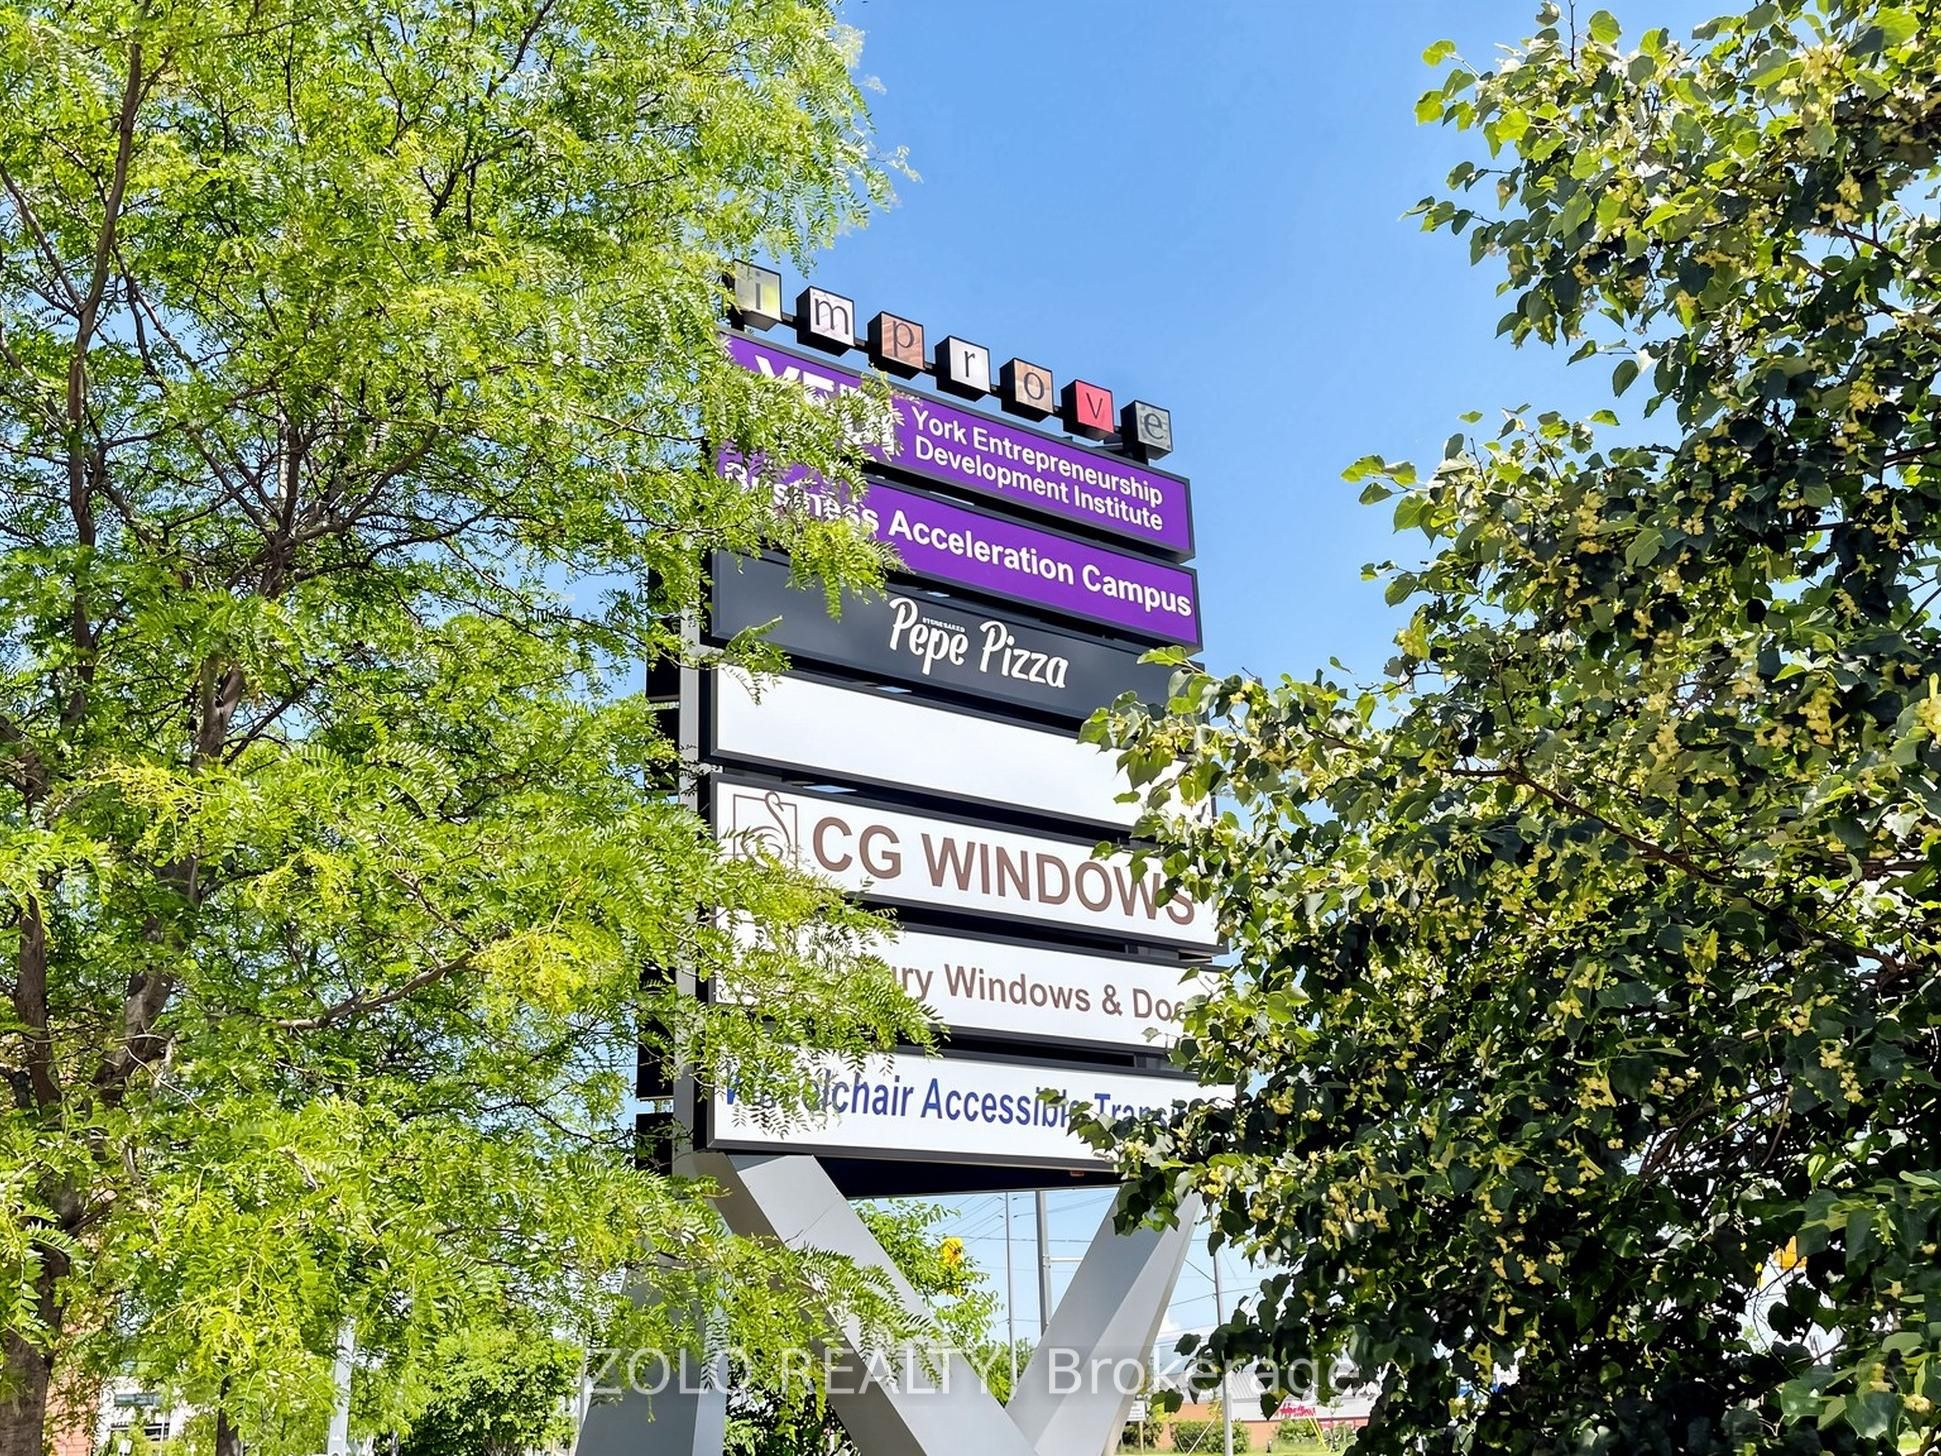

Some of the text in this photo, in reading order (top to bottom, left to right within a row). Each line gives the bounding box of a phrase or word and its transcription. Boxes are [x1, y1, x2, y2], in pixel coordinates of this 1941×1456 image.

[911, 407, 1163, 507] York Entrepreneurship
[915, 434, 1163, 533] Development Institute
[888, 509, 1075, 585] Acceleration
[1081, 564, 1192, 617] Campus
[889, 597, 1069, 689] Pepe Pizza
[812, 816, 1196, 926] CG WINDOWS
[944, 963, 1091, 1012] Windows
[1102, 984, 1123, 1017] &
